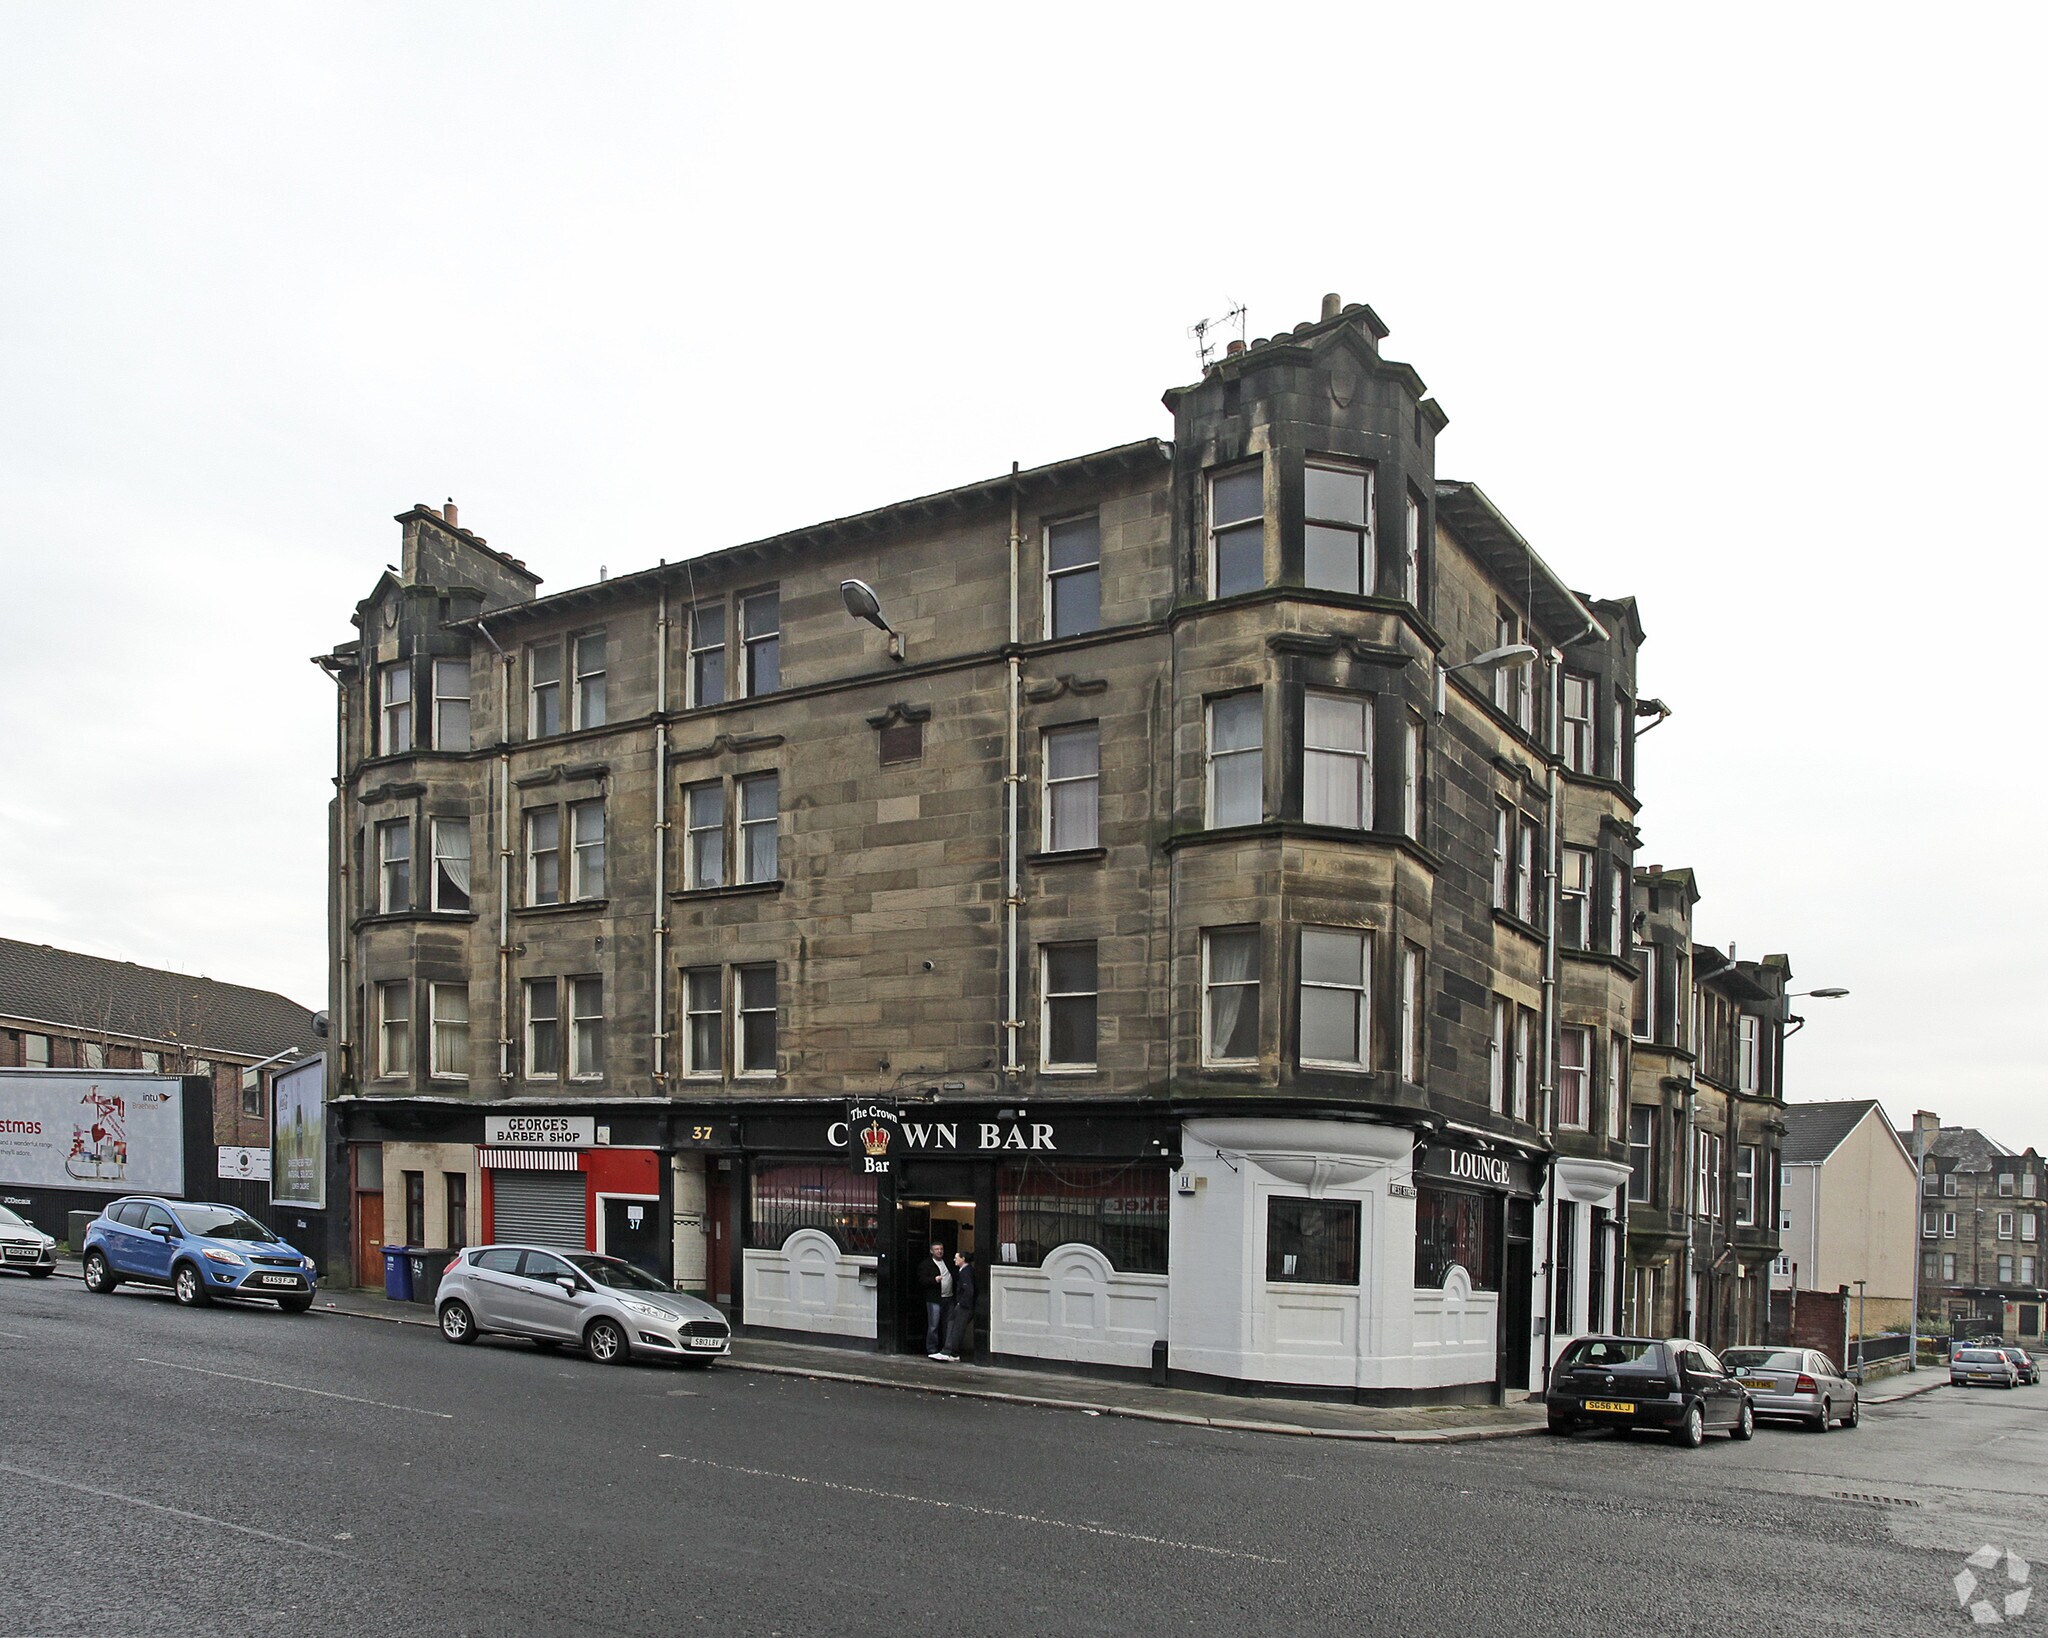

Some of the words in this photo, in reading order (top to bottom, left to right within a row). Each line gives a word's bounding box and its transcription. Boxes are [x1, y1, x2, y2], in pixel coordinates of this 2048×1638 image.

[142, 1092, 159, 1102] intu
[850, 1107, 868, 1121] The
[868, 1105, 898, 1124] Crown
[508, 1118, 569, 1131] GEORGE'S
[497, 1131, 544, 1142] BARBER
[549, 1131, 581, 1143] SHOP
[692, 1126, 713, 1140] 37
[827, 1122, 958, 1149] CWN
[978, 1123, 1058, 1150] BAR
[864, 1157, 890, 1173] Bar
[1450, 1149, 1510, 1185] LOUNGE
[629, 1219, 641, 1230] 37
[1589, 1401, 1611, 1410] SG56
